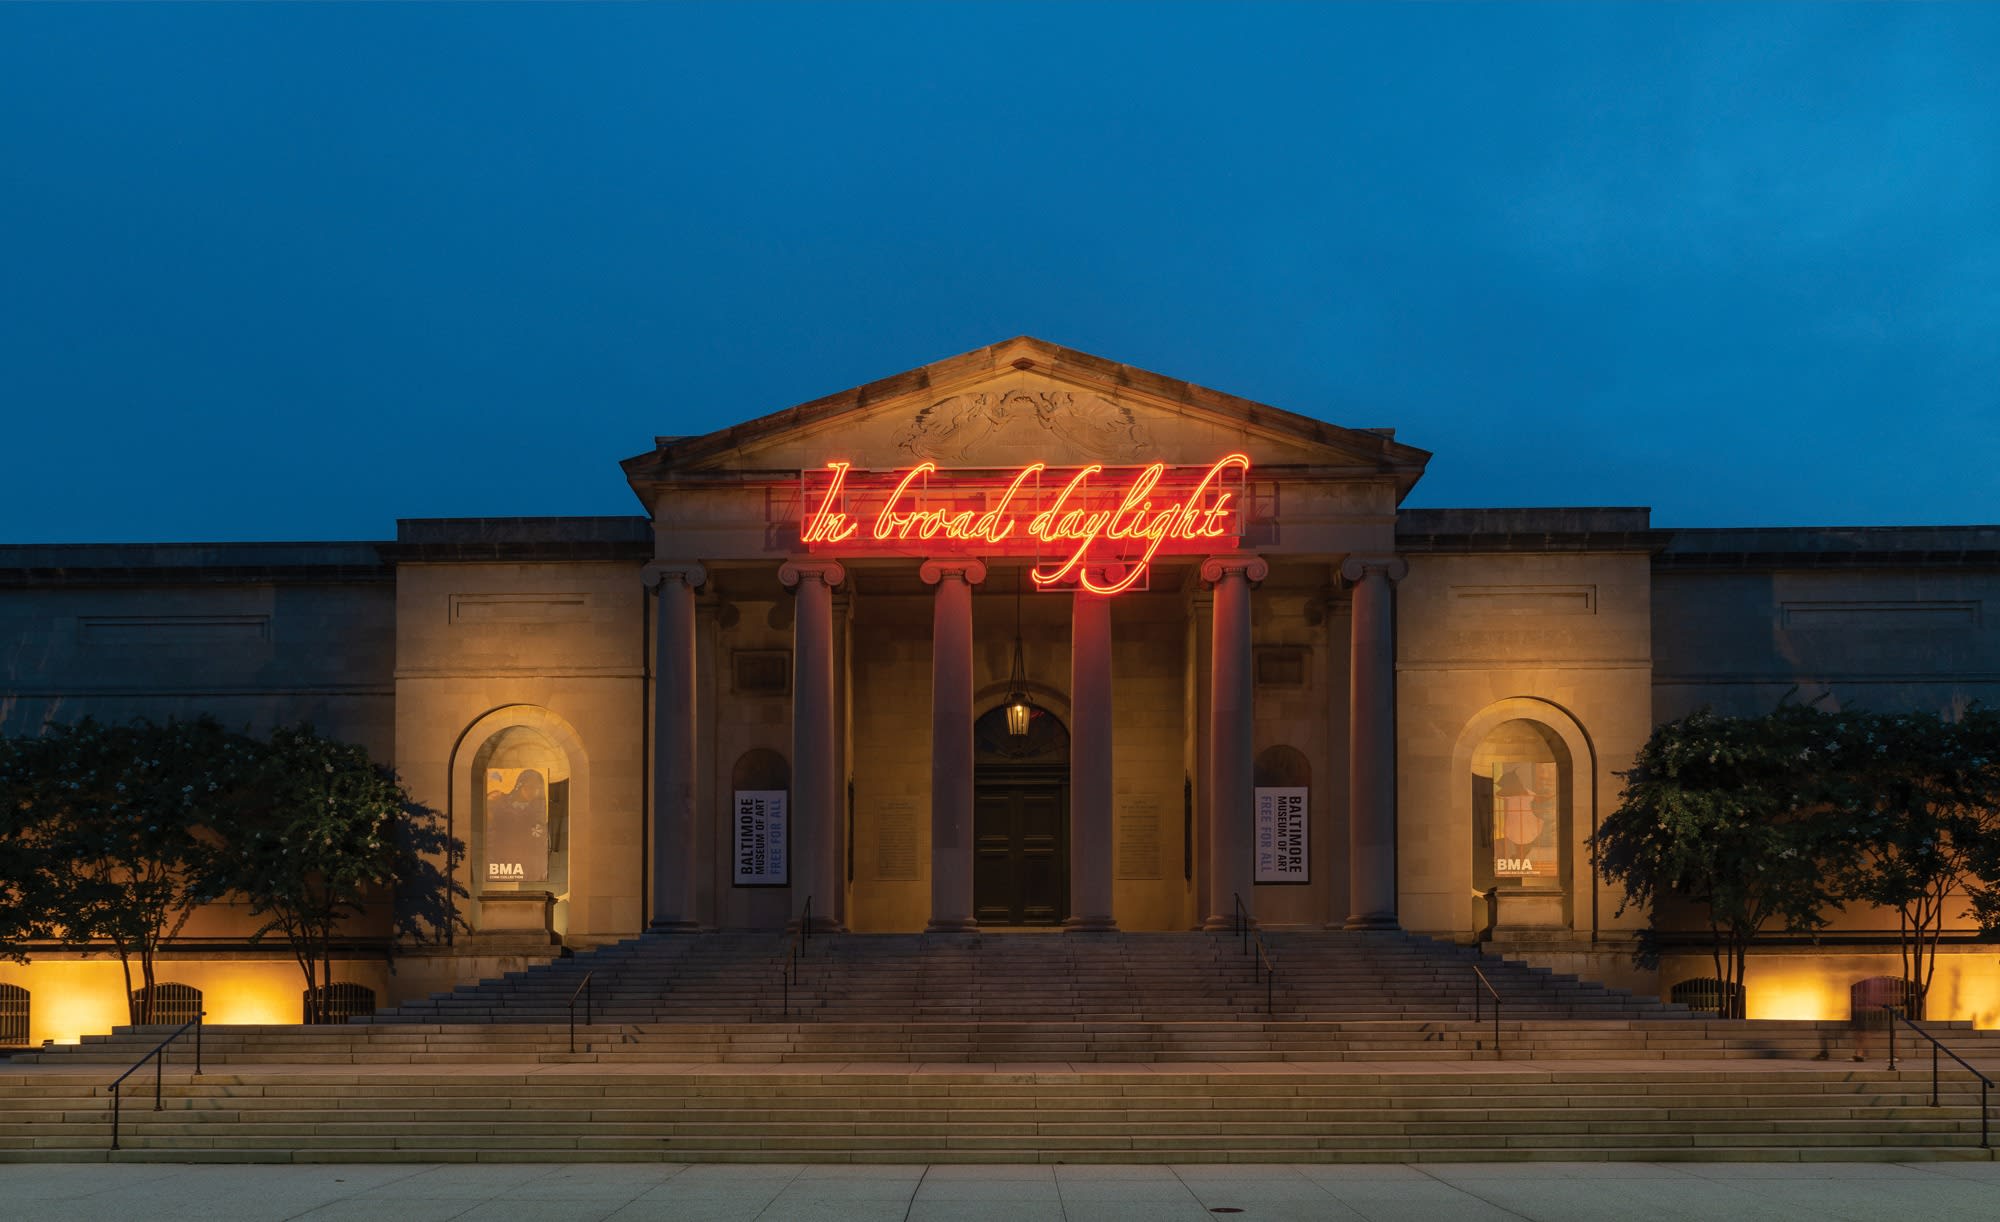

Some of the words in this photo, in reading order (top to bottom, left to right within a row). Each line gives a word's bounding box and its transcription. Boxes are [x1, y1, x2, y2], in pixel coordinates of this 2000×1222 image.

[802, 462, 858, 543] In
[873, 462, 1045, 544] broad
[1028, 453, 1249, 595] daylight
[755, 798, 765, 817] ART
[770, 799, 782, 818] ALL
[1260, 795, 1272, 823] FREE
[1277, 796, 1287, 838] MUSEUM
[740, 798, 754, 875] BALTIMORE
[755, 821, 765, 831] OF
[770, 822, 782, 845] FOR
[1289, 796, 1302, 873] BALTIMORE
[1260, 827, 1272, 848] FOR
[1277, 840, 1287, 852] OF
[755, 833, 765, 875] MUSEUM
[770, 848, 782, 875] FREE
[1260, 852, 1273, 872] ALL
[1277, 854, 1288, 873] ART
[1497, 858, 1533, 871] BMA
[489, 863, 524, 875] BMA
